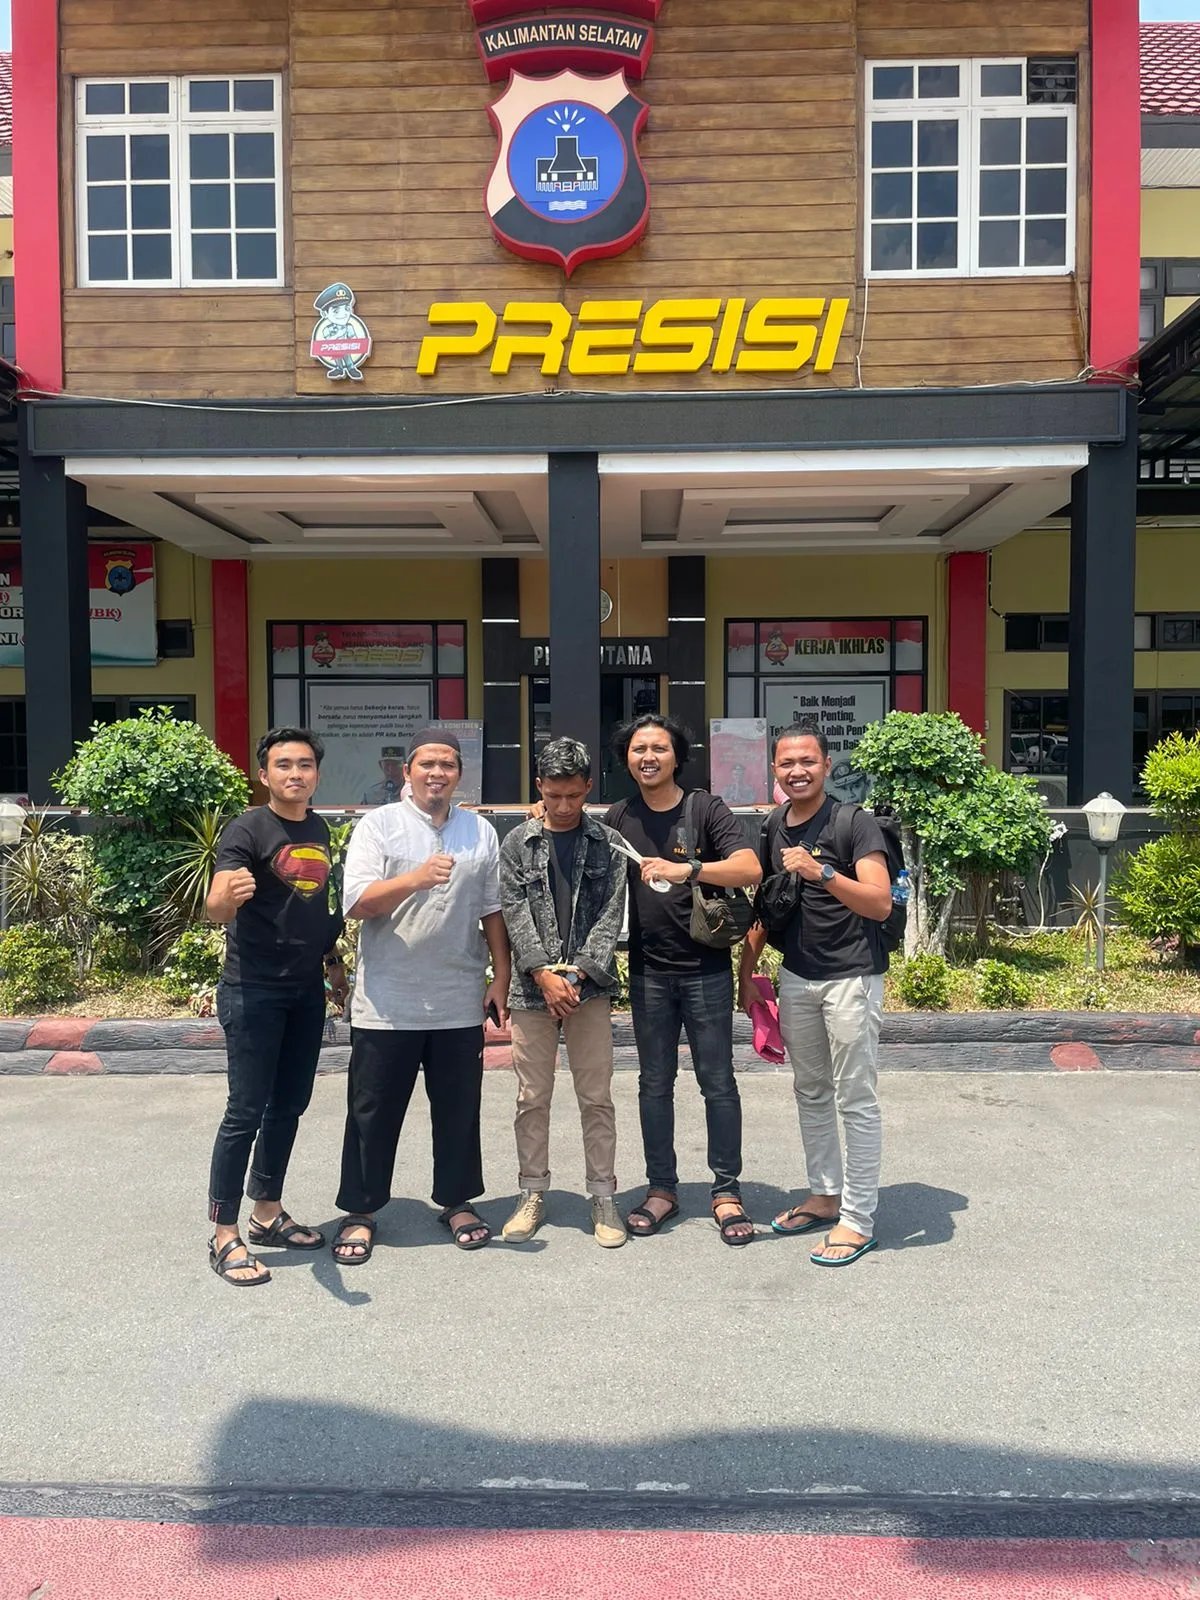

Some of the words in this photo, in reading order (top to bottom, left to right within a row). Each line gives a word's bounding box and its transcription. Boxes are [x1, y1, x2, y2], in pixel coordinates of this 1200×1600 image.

[485, 24, 575, 51] KALIMANTAN
[579, 24, 642, 50] SELATAN
[416, 298, 850, 376] PRESISI
[320, 343, 360, 351] PRESISI
[794, 639, 836, 655] KERJA
[839, 638, 885, 655] IKHLAS
[800, 696, 819, 707] Baik
[821, 695, 856, 708] Menjadi
